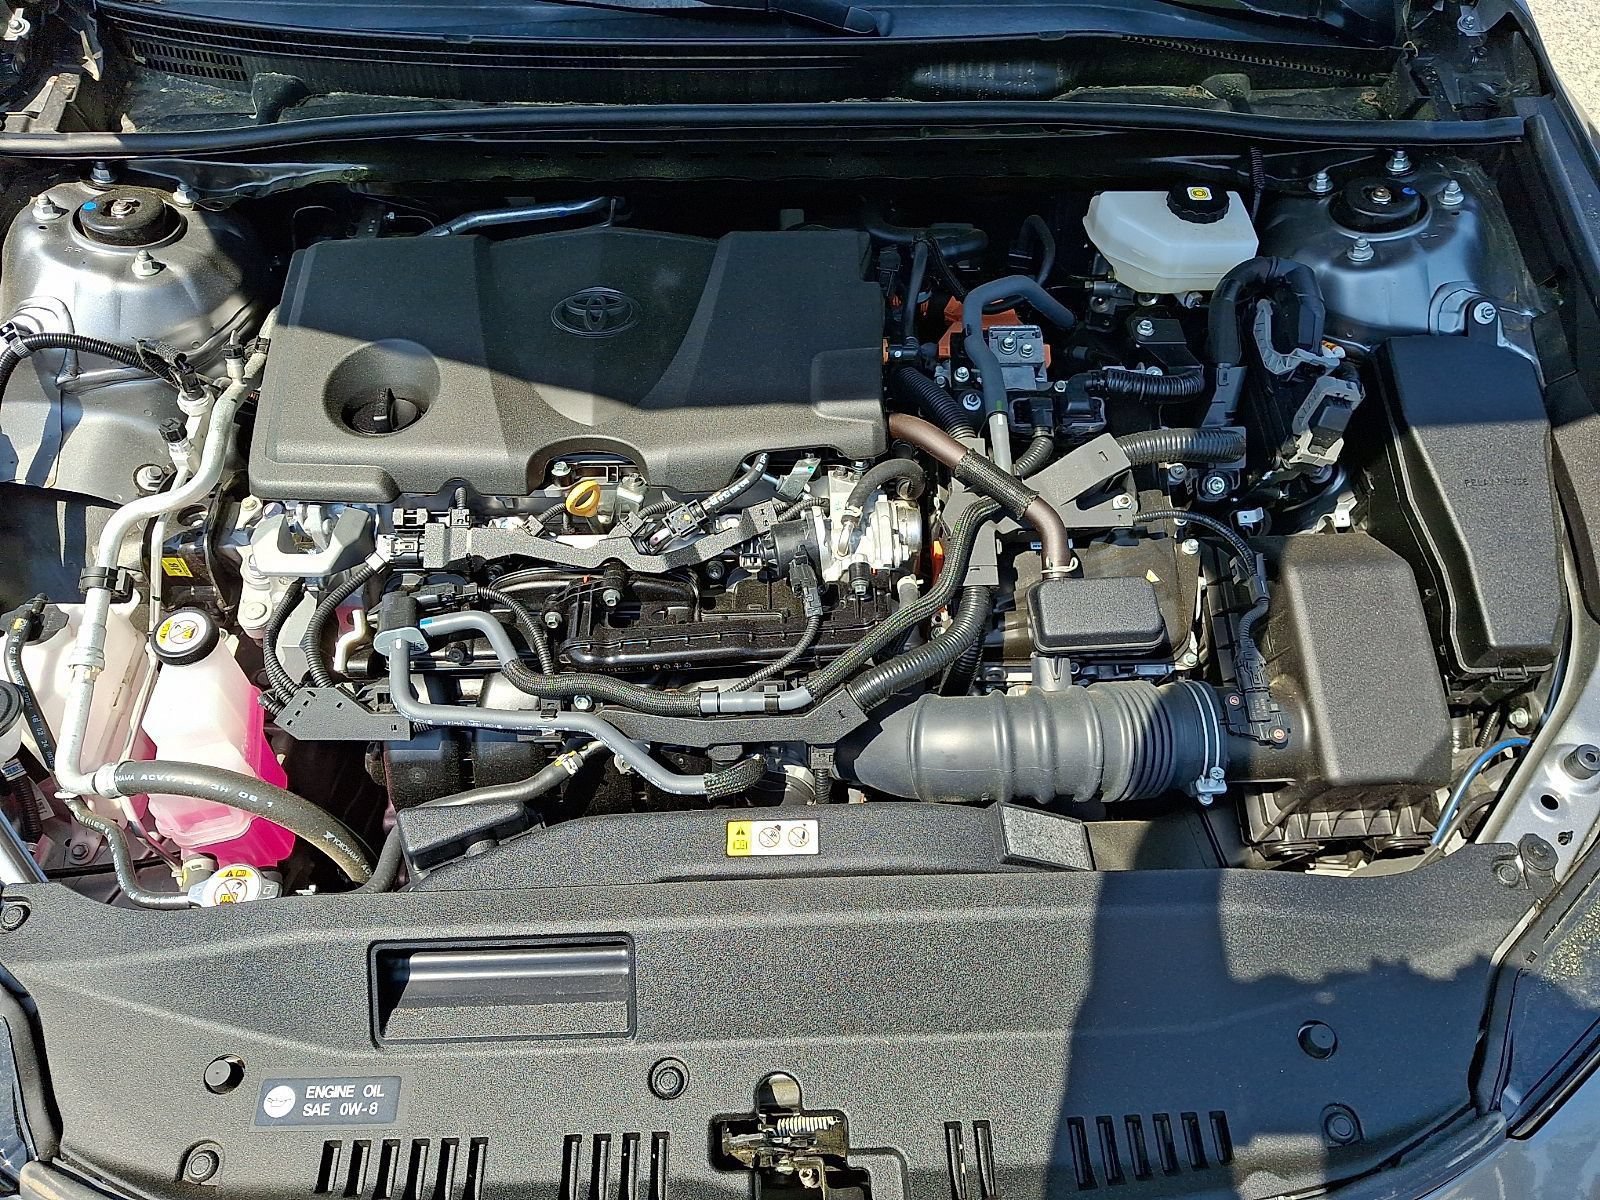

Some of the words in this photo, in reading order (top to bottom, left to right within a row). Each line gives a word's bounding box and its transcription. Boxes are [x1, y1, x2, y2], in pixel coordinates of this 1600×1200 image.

[305, 1085, 356, 1099] ENGINE
[362, 1084, 385, 1098] OIL
[302, 1103, 331, 1117] SAE
[339, 1102, 379, 1116] 0W-8
